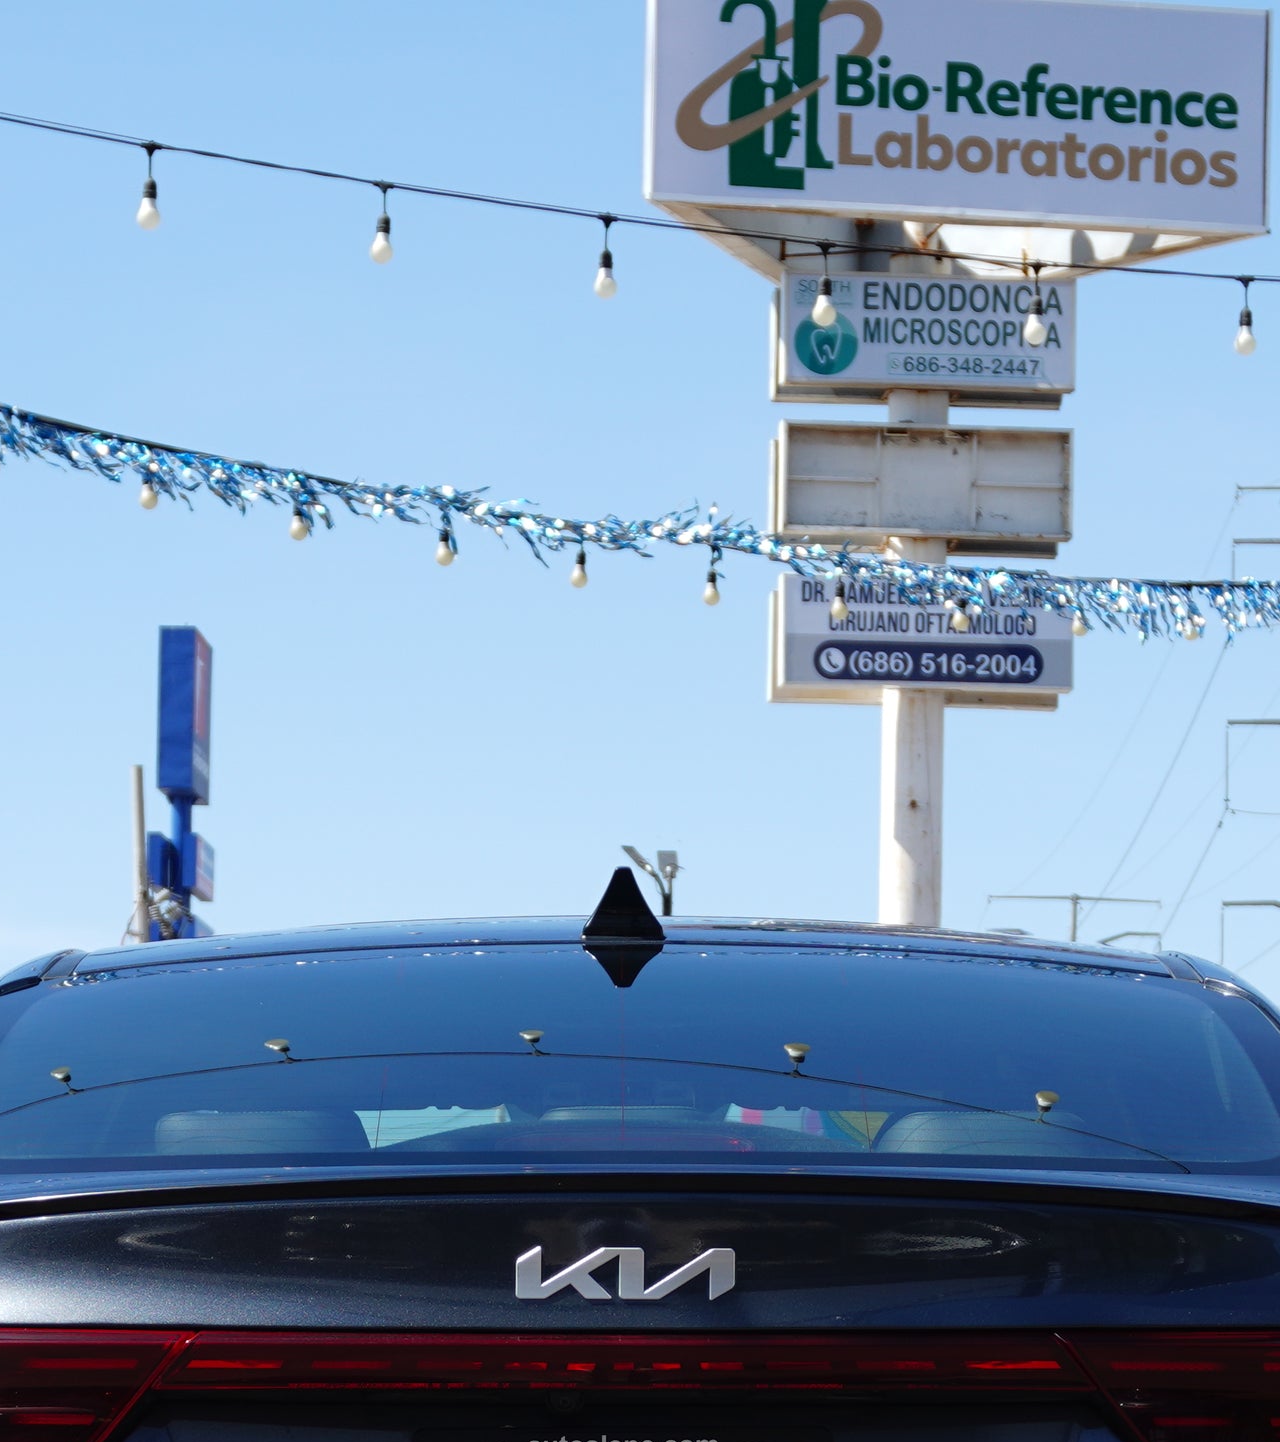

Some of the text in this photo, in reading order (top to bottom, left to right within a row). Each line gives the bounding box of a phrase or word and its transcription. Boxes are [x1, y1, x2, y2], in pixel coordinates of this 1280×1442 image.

[835, 53, 1239, 130] Bio-Reference
[837, 112, 1239, 189] Laboratorios
[798, 279, 851, 293] SOTH
[863, 281, 1063, 315] ENDODONCA
[863, 317, 1061, 349] MICROSCOPIA
[903, 356, 1040, 376] 686-348-2447
[801, 580, 828, 602] DR.
[915, 613, 1037, 636] OFTAMOLOGO
[849, 650, 1037, 677] (686) 516-2004
[516, 1245, 736, 1300] KIA
